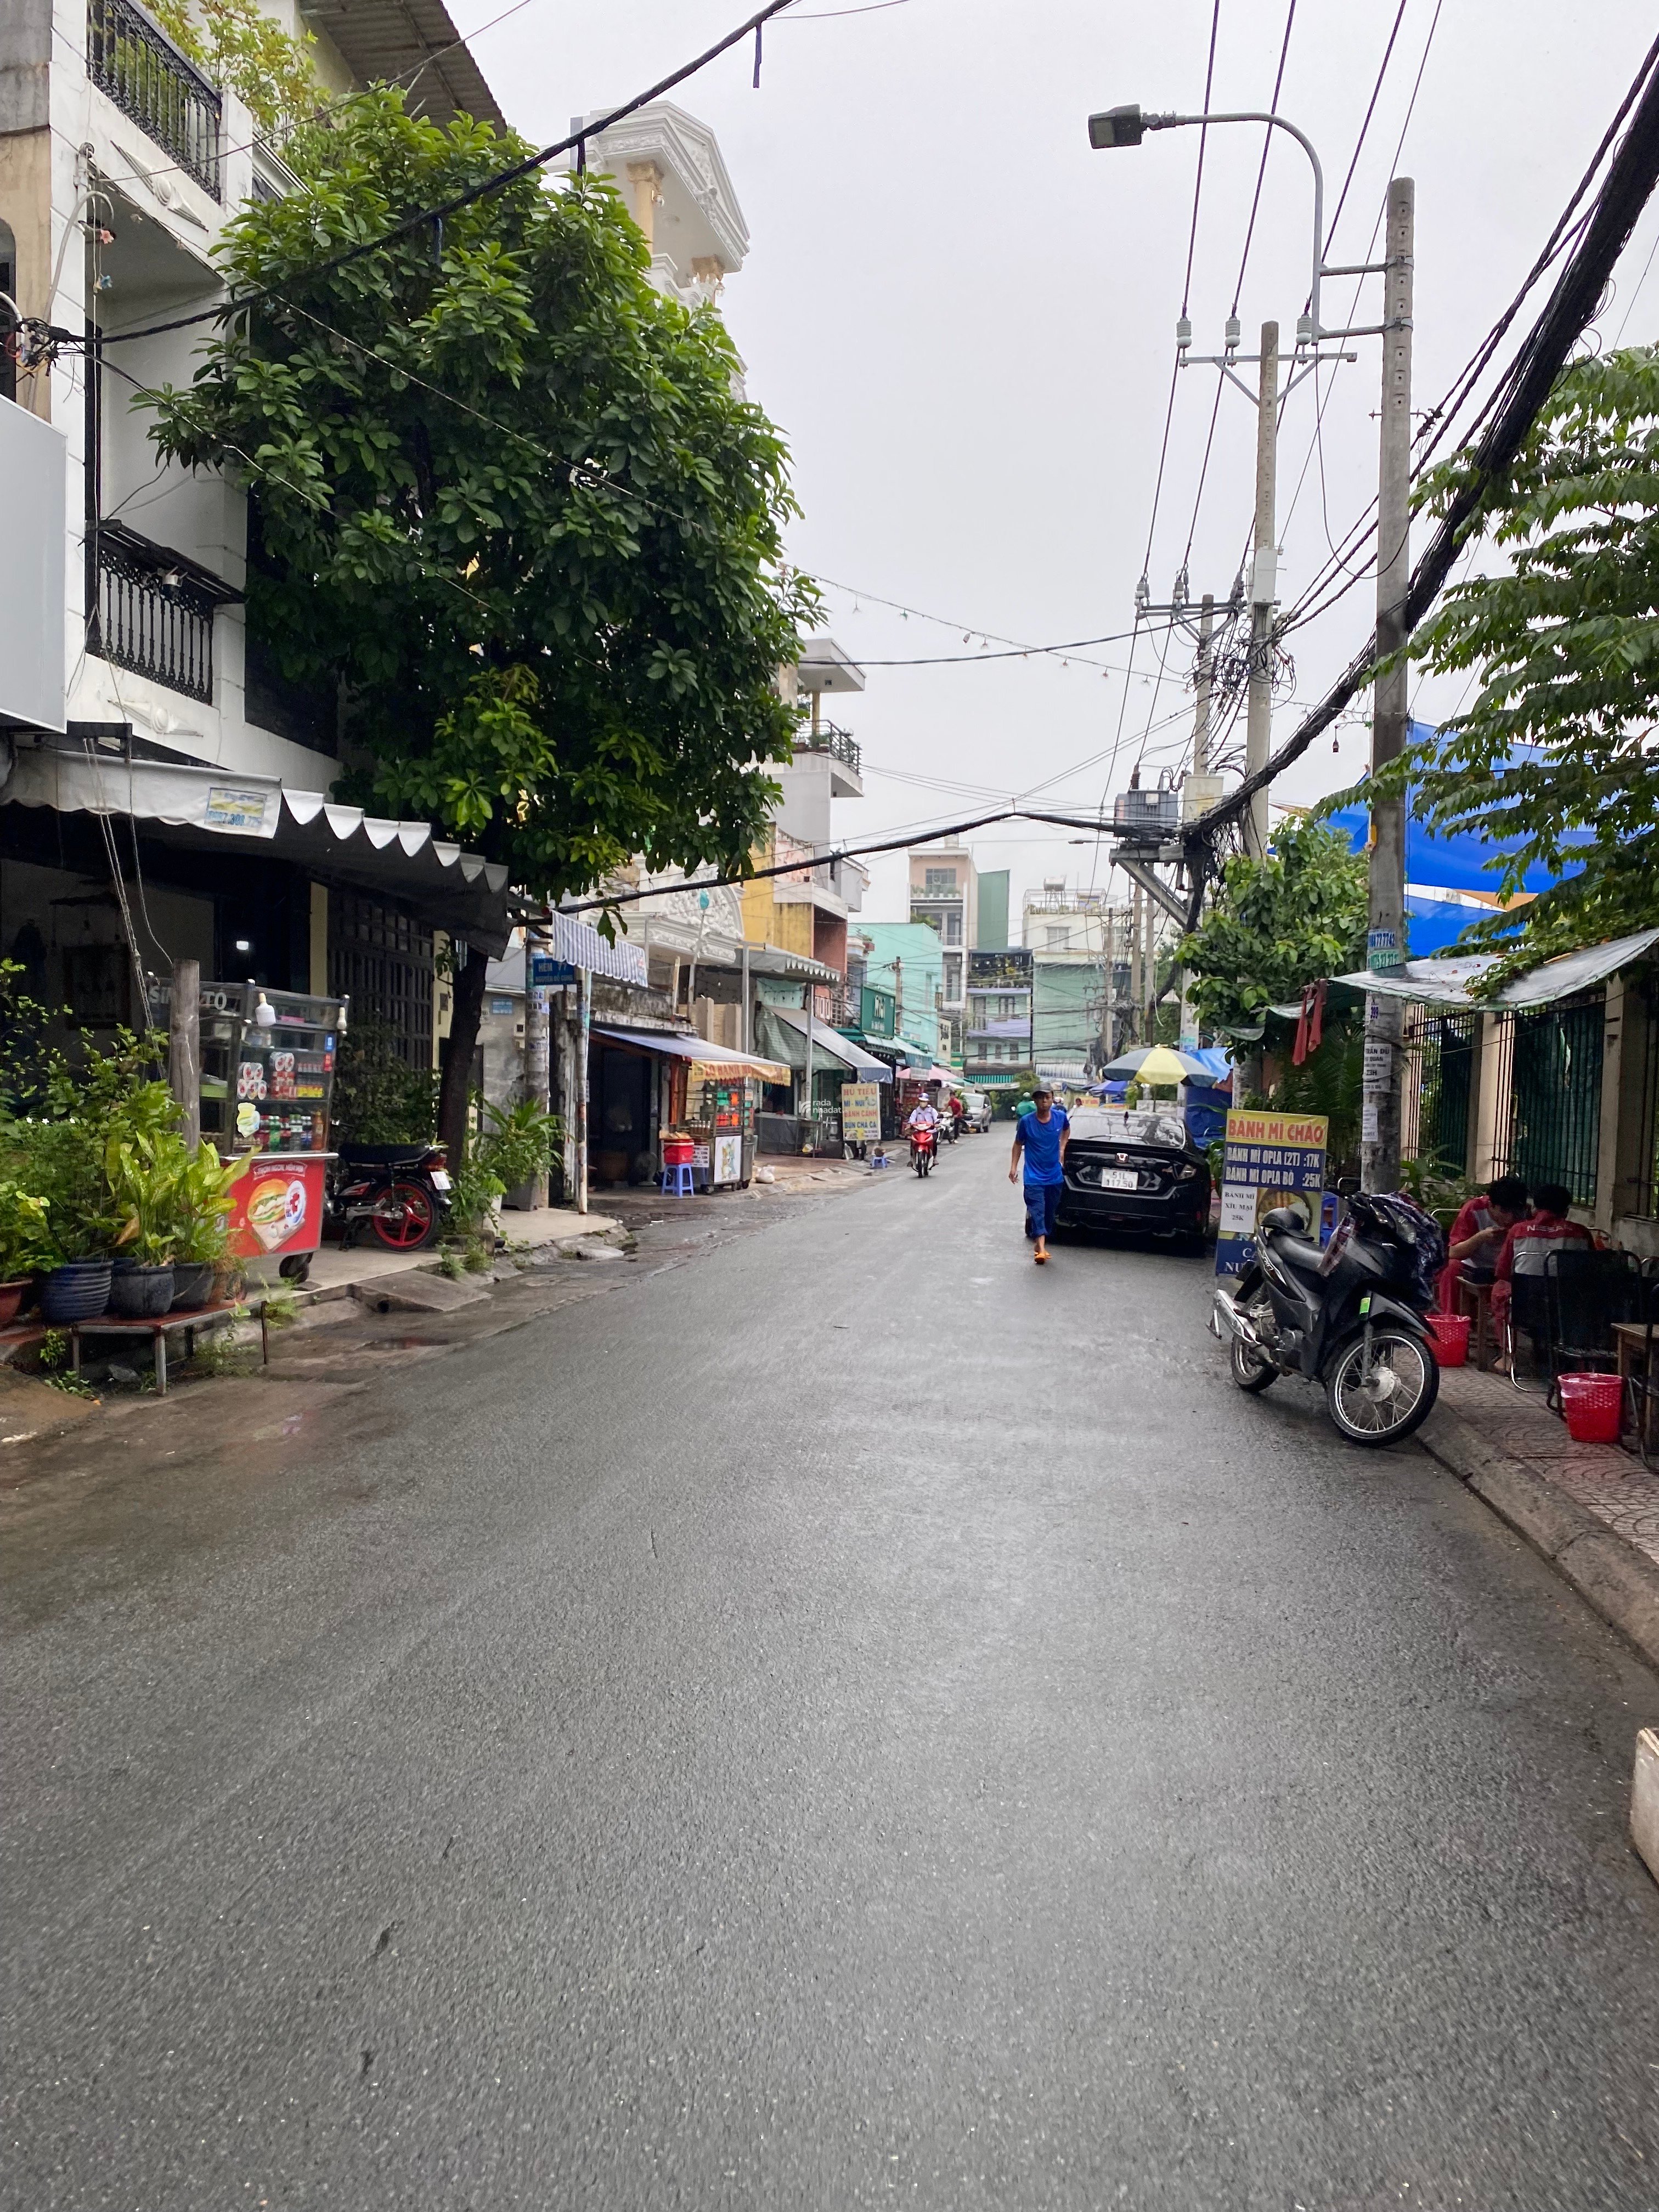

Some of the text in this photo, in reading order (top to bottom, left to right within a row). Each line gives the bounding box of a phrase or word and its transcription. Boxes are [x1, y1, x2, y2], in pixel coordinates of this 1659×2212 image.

[1228, 1116, 1265, 1138] BÁNH
[1268, 1119, 1284, 1140] MÌ
[1227, 1146, 1249, 1162] BÁNH
[1250, 1147, 1261, 1163] MÌ
[1262, 1150, 1282, 1165] OPLA
[1112, 1171, 1126, 1180] 51L
[1226, 1165, 1247, 1182] BÁNH
[1249, 1167, 1260, 1183] MÌ
[1261, 1170, 1280, 1185] OPLA
